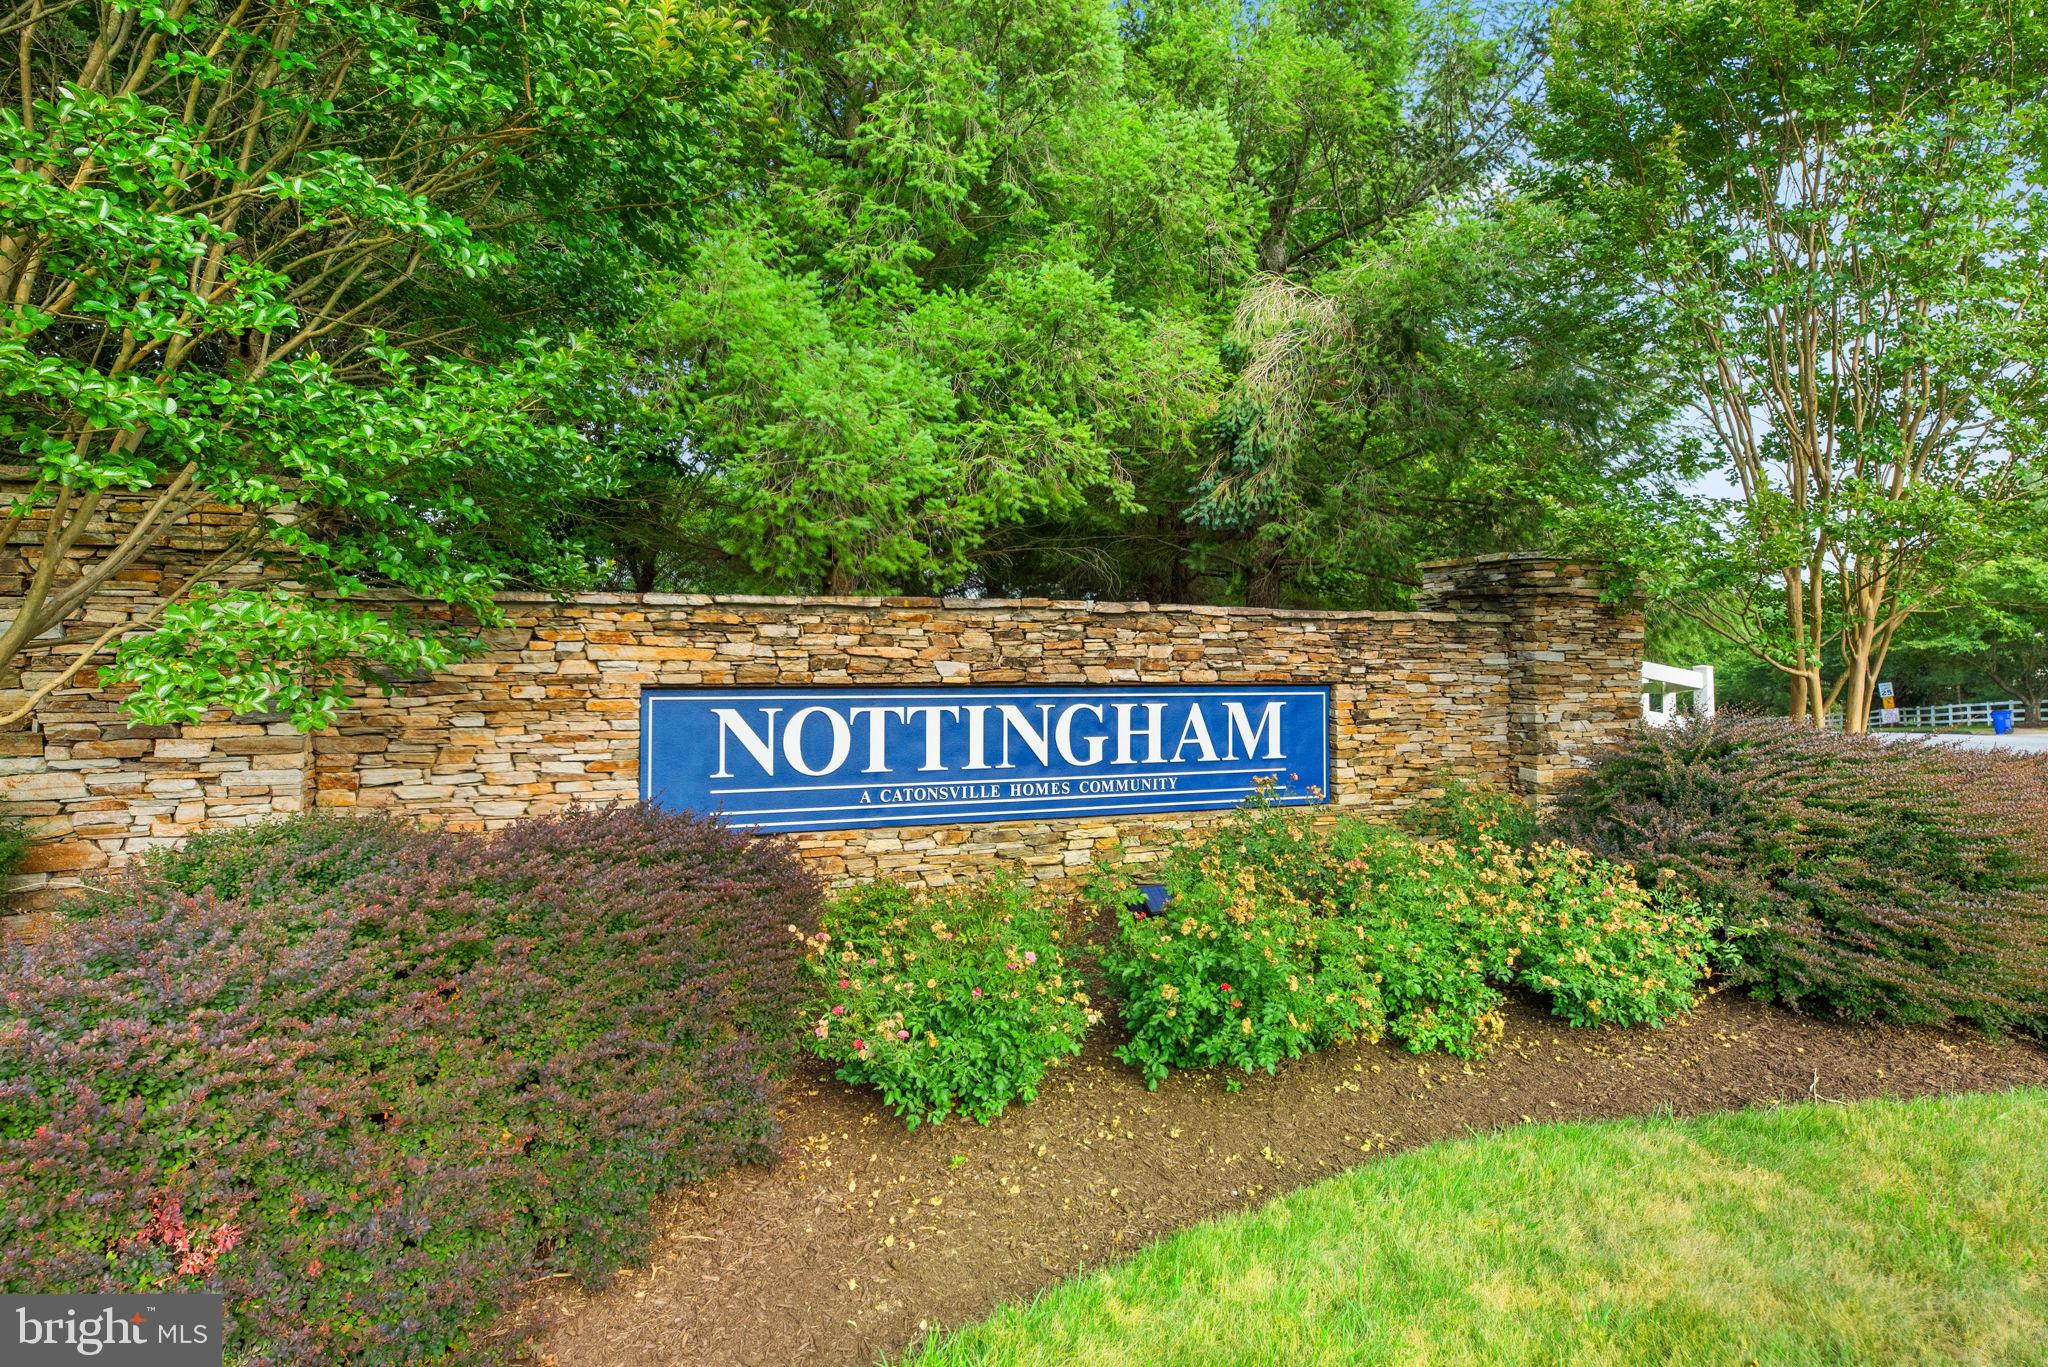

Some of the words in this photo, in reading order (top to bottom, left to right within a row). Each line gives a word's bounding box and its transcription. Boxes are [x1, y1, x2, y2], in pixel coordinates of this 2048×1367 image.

[709, 701, 1288, 779] NOTTINGHAM
[859, 790, 872, 804] A
[880, 784, 1001, 803] CATONSVILLE
[1010, 781, 1071, 797] HOMES
[1079, 777, 1178, 793] COMMUNITY
